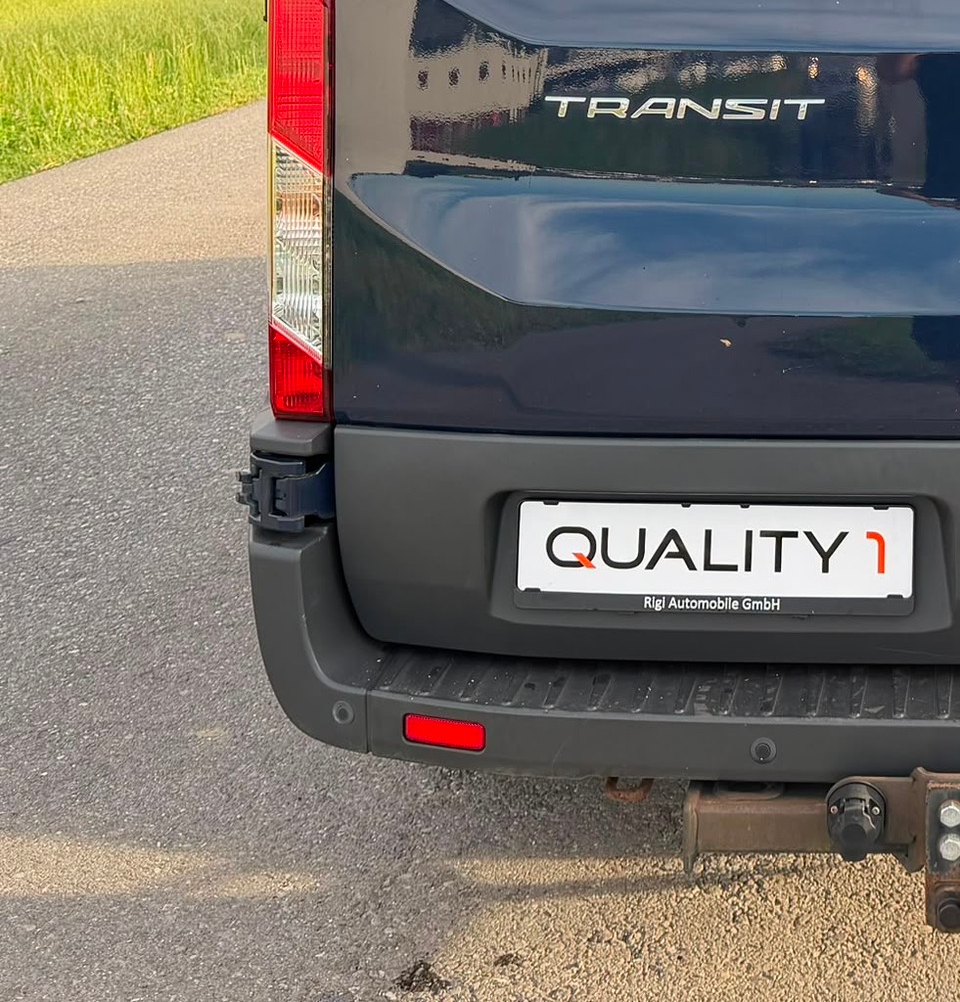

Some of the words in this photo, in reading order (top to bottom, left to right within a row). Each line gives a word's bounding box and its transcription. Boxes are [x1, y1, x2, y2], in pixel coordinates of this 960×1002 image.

[544, 95, 826, 121] TRANSIT
[546, 526, 849, 574] QUALITY
[643, 595, 666, 611] Rigi
[668, 596, 739, 610] Automobile
[741, 597, 781, 611] GmbH
